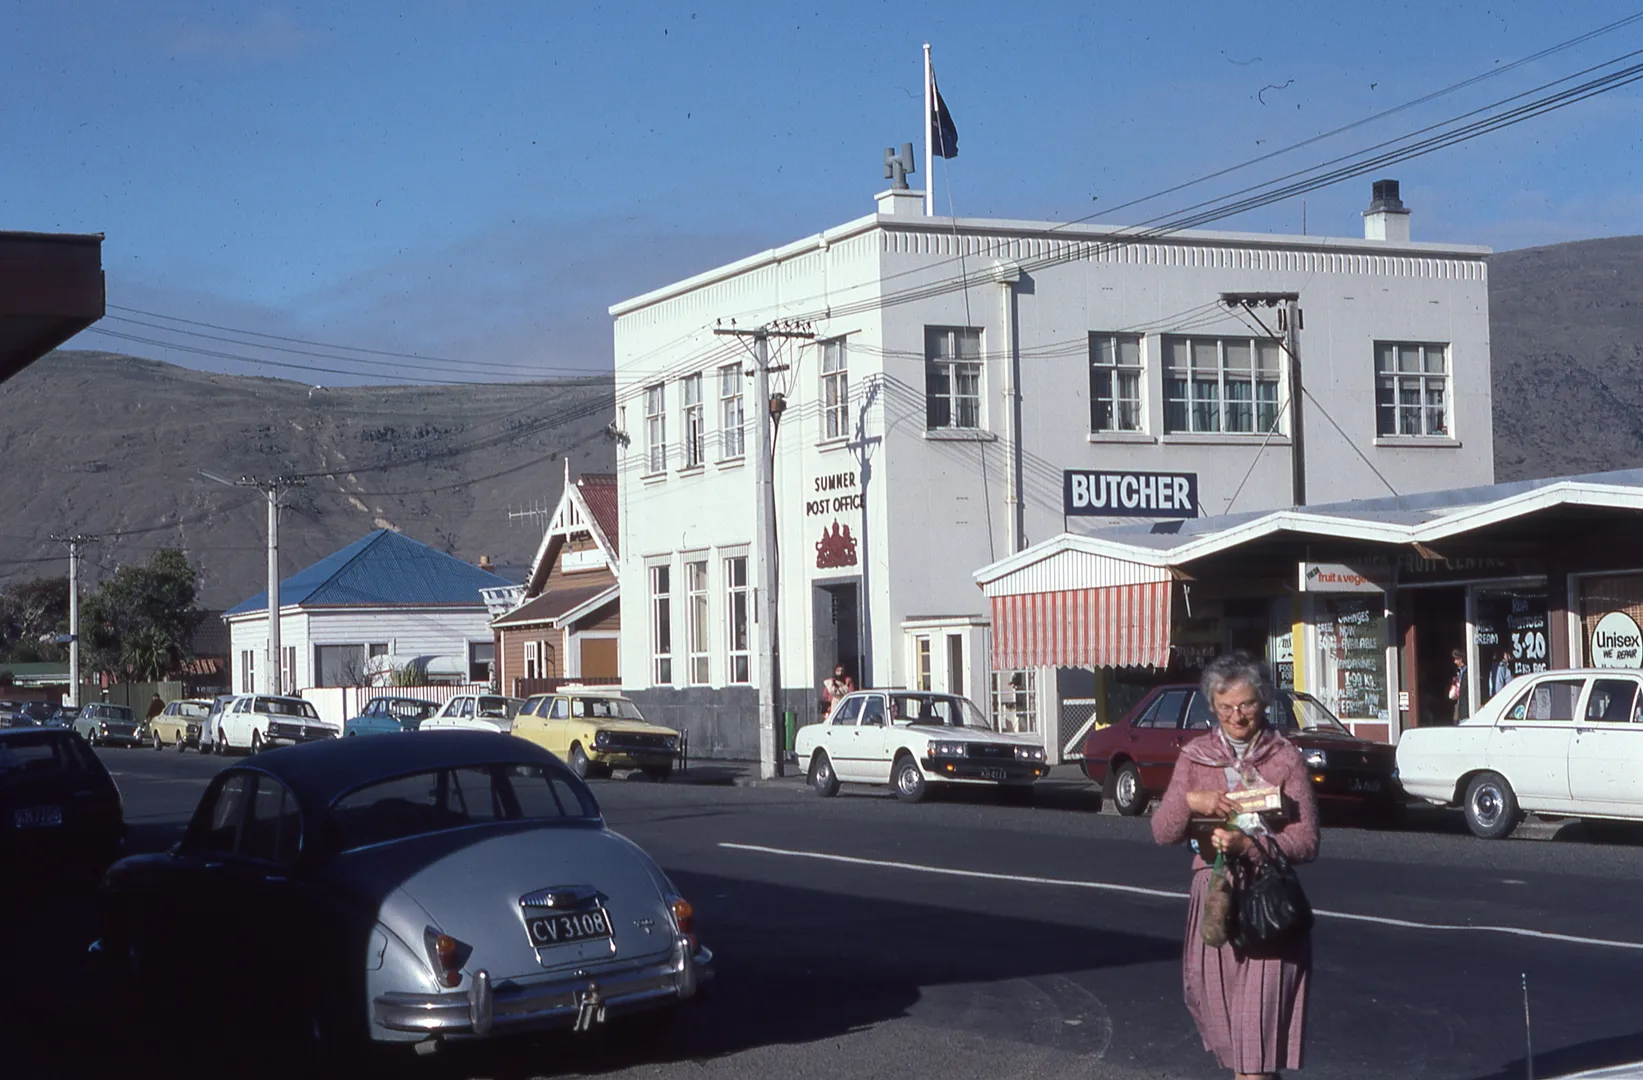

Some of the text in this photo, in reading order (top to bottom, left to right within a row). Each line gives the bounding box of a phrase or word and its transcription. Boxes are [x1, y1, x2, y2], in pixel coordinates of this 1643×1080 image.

[815, 471, 856, 492] SUMNER
[1071, 473, 1192, 510] BUTCHER
[806, 493, 865, 516] POST OFFICE
[1318, 572, 1336, 583] fruit
[1596, 631, 1640, 648] Unisex
[532, 914, 606, 941] CV 3108
